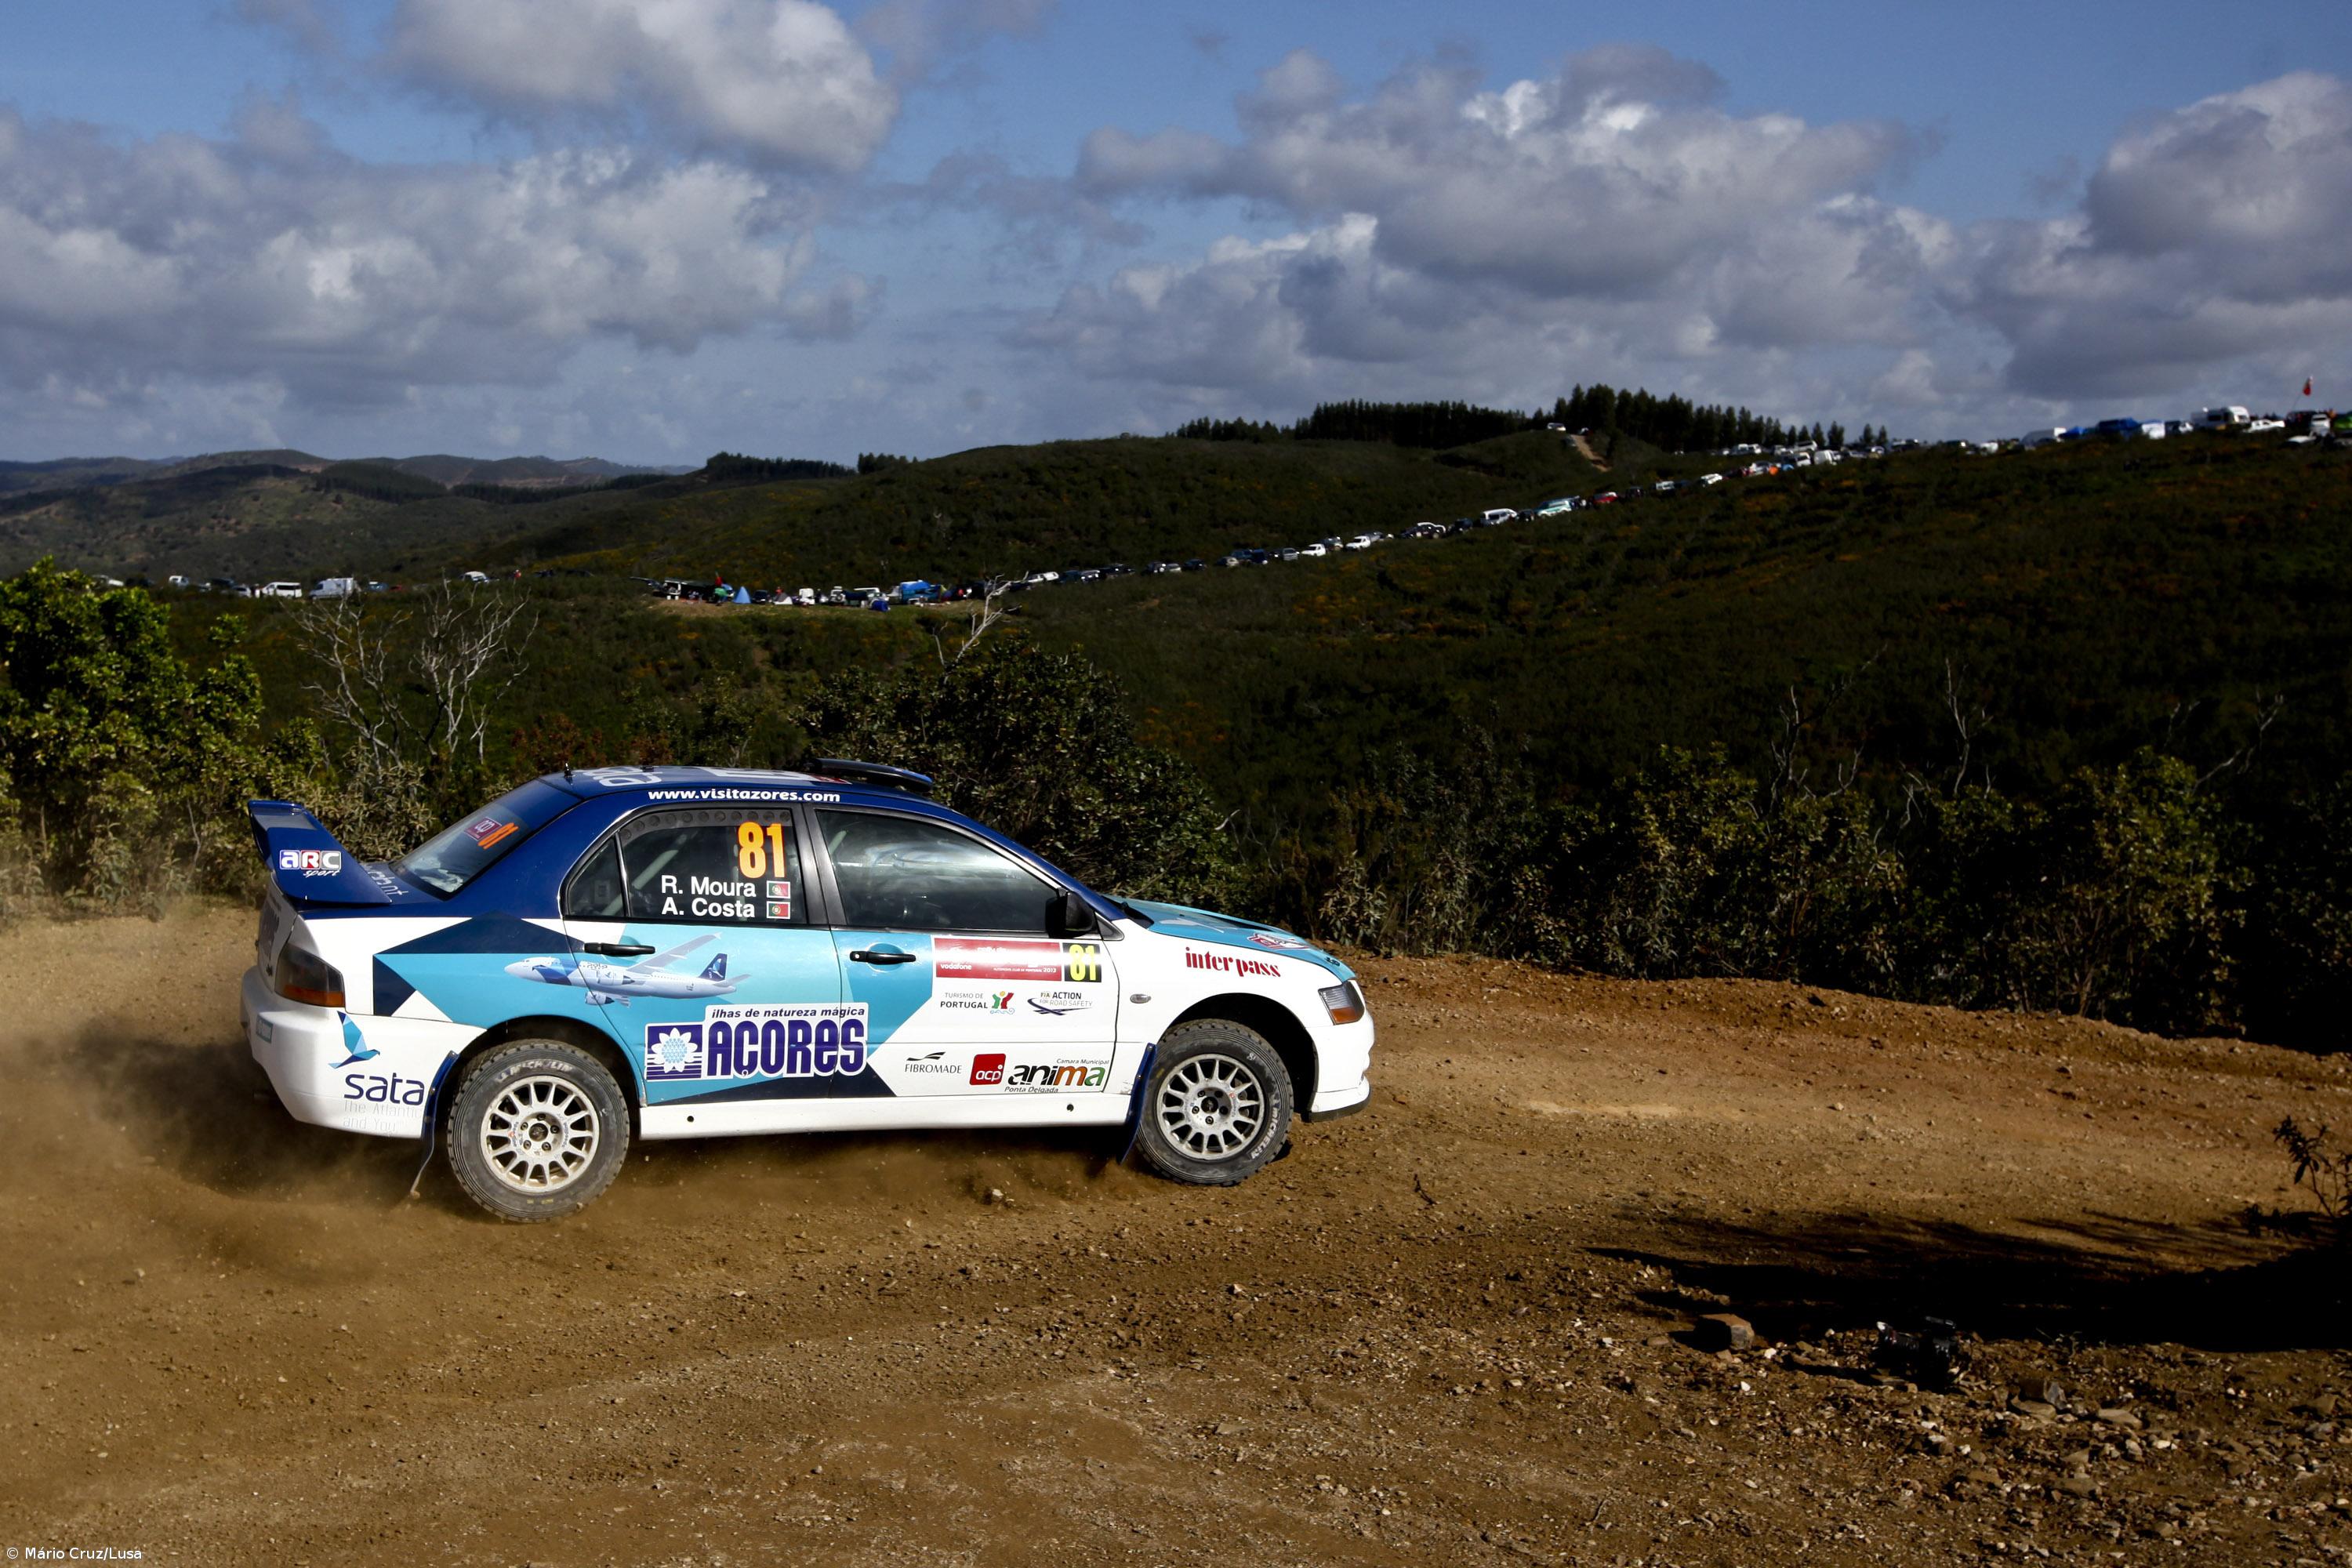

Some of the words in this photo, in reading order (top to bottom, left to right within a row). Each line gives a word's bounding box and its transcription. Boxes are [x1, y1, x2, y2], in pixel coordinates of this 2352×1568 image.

[648, 787, 840, 802] www.visitazores.com
[737, 822, 785, 878] 81
[303, 869, 341, 878] sport
[661, 874, 684, 895] R.
[691, 876, 756, 897] Moura
[661, 896, 684, 916] A.
[691, 898, 756, 918] Costa
[1069, 944, 1097, 981] 81
[1052, 991, 1082, 1000] ACTION
[940, 1000, 989, 1009] PORTUGAL
[711, 1008, 741, 1018] ilhas
[745, 1008, 760, 1018] de
[764, 1008, 817, 1018] natureza
[820, 1007, 866, 1018] mágica
[905, 1063, 962, 1074] FIBROMADE
[975, 1069, 1002, 1082] acp
[1007, 1064, 1106, 1087] anima
[344, 1073, 425, 1105] sata
[344, 1099, 366, 1113] The
[343, 1116, 367, 1130] and
